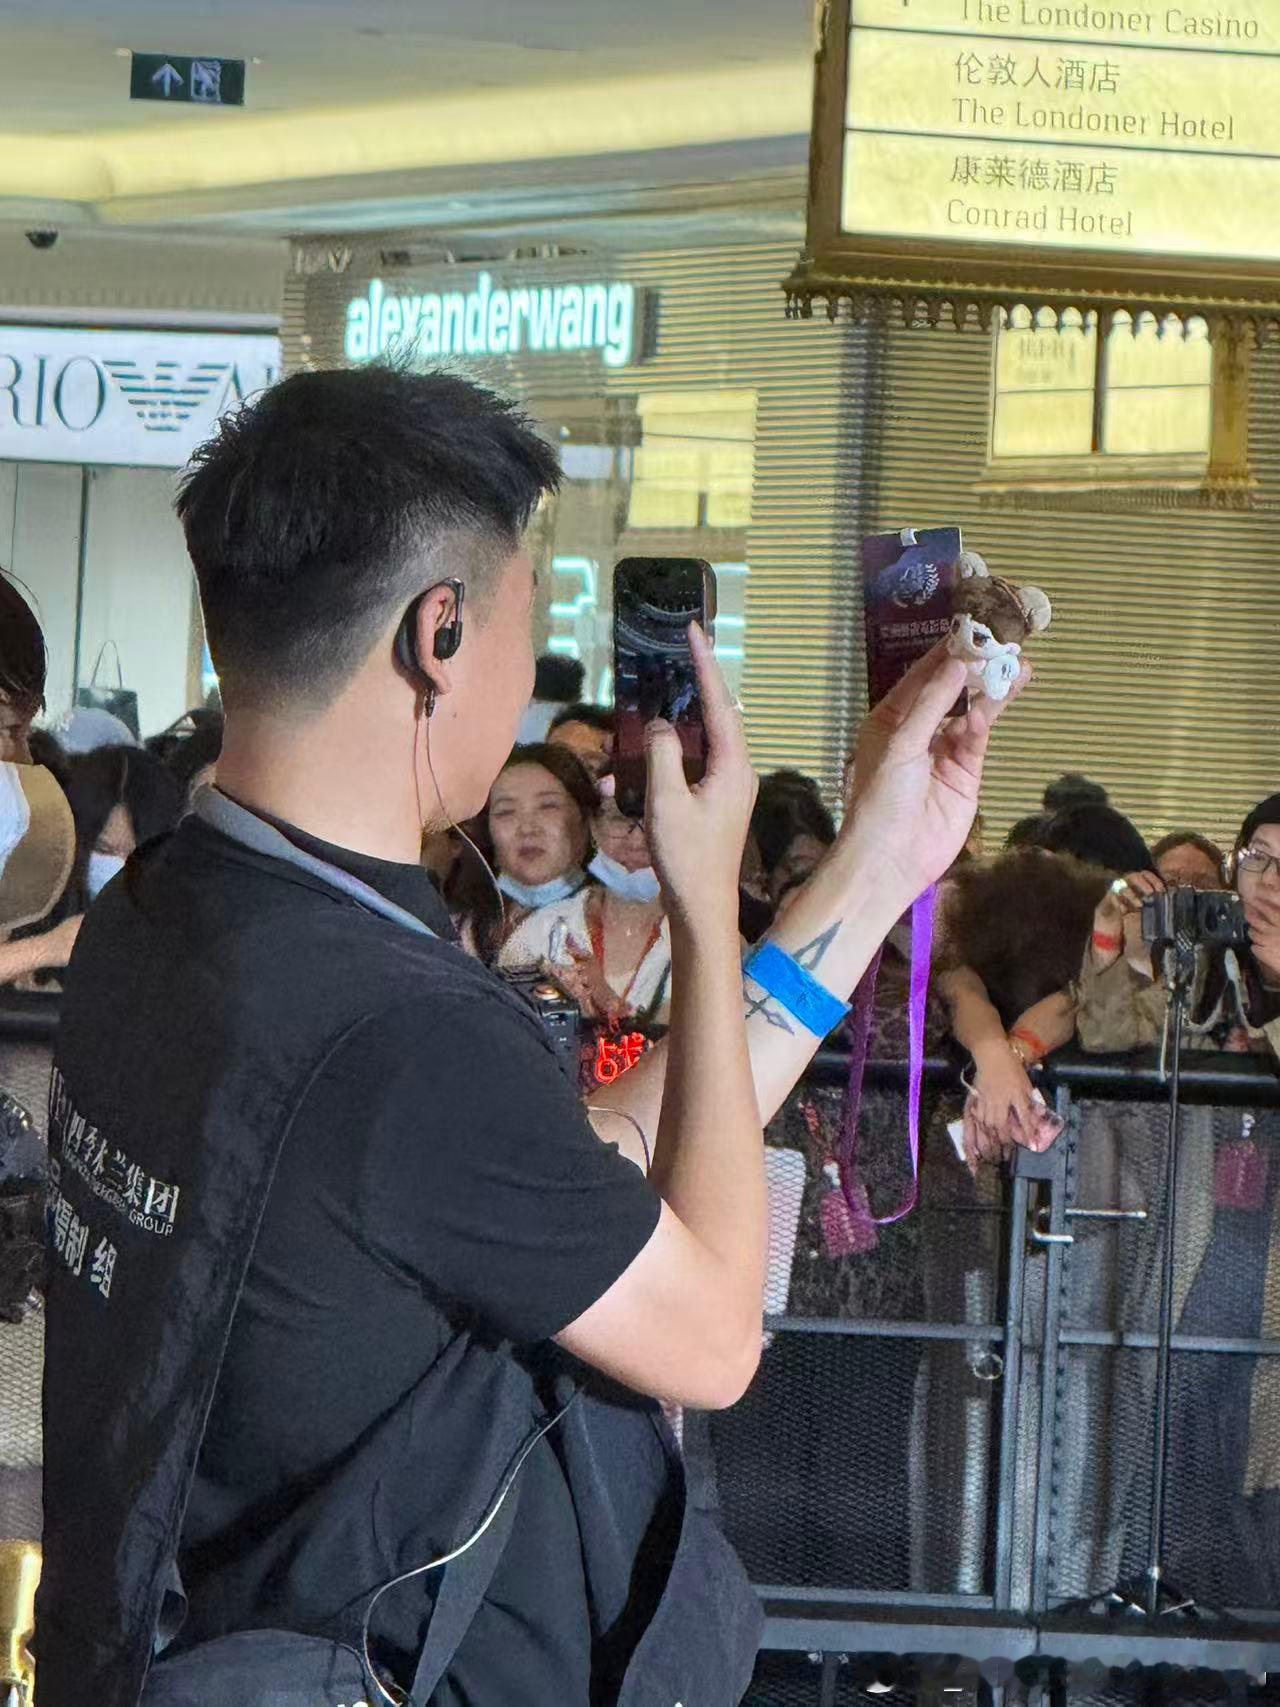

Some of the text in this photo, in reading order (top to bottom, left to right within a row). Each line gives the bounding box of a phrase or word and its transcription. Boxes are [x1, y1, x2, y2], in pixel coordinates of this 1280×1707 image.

[961, 0, 1260, 41] The Londoner Casino
[953, 50, 1121, 94] 伦敦人酒店
[951, 96, 1235, 141] The Londoner Hotel
[949, 154, 1120, 195] 康莱德酒店
[947, 198, 1134, 238] Conrad Hotel
[345, 270, 635, 367] alexanderwang
[129, 1208, 174, 1237] GROUP
